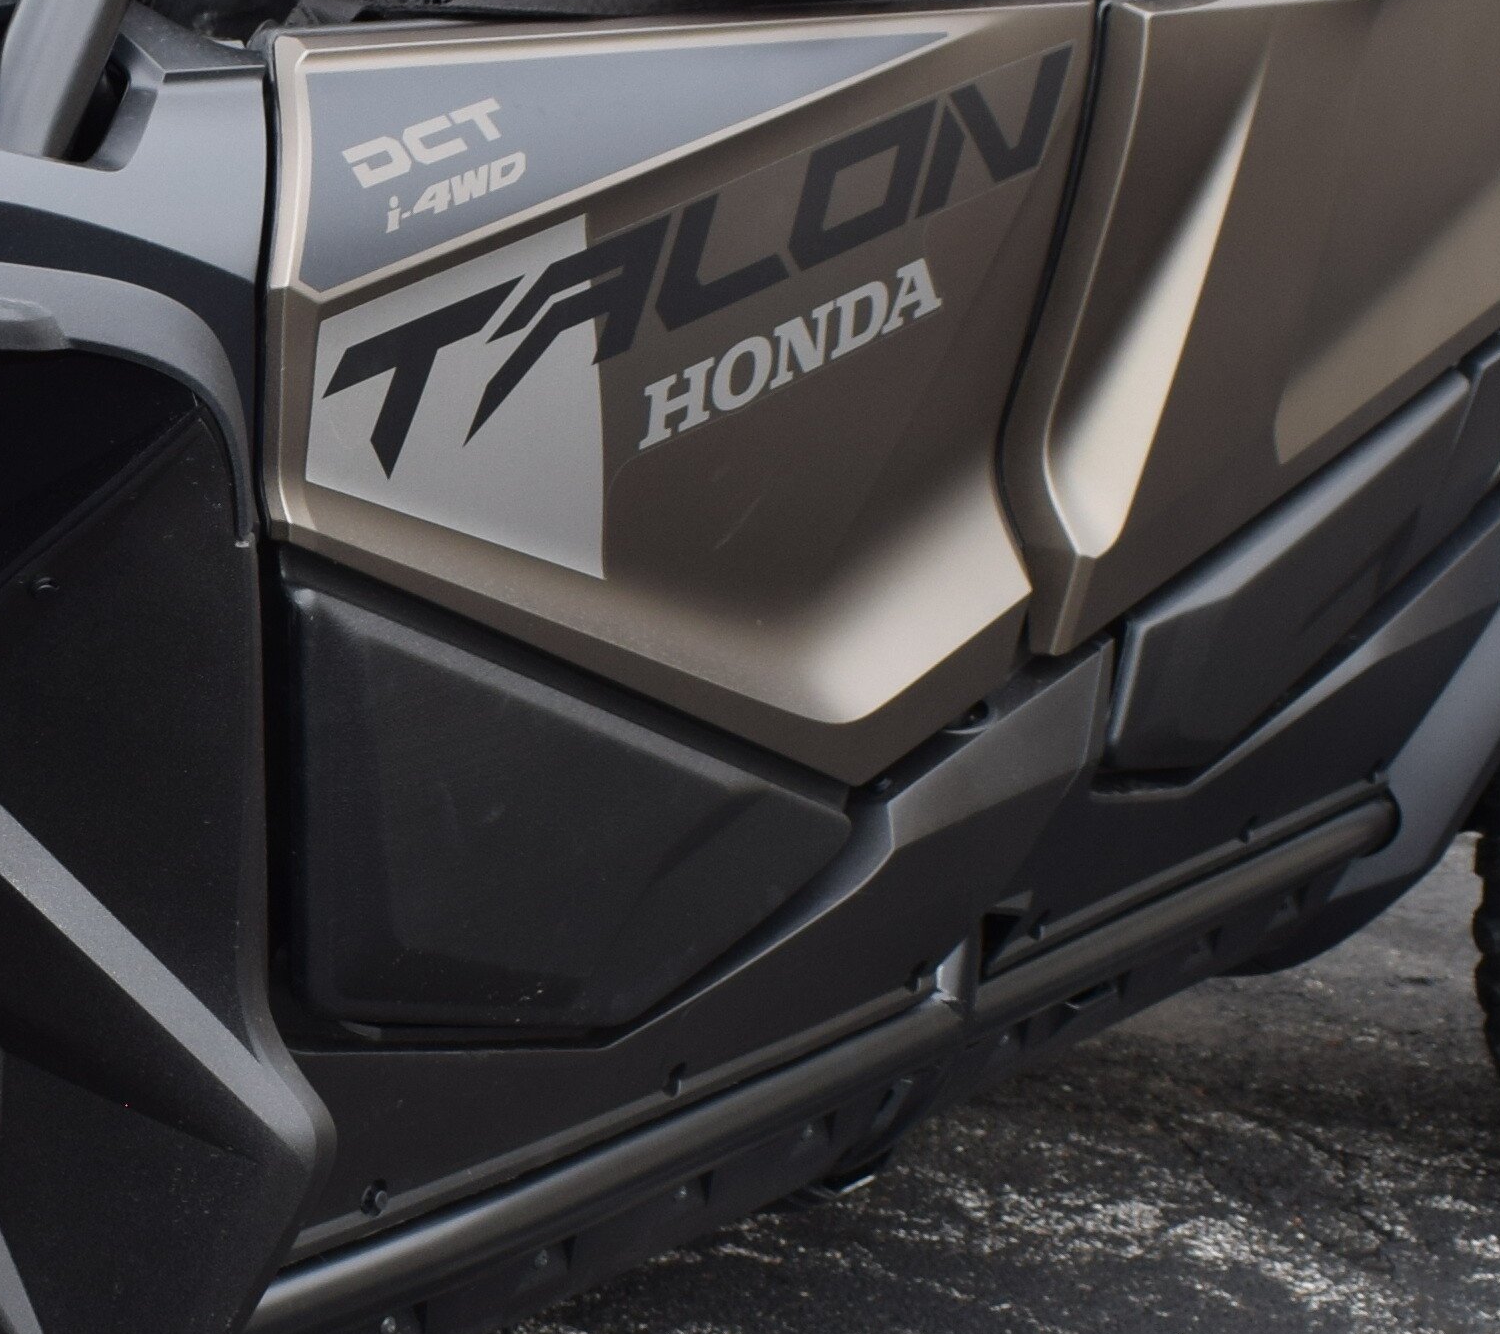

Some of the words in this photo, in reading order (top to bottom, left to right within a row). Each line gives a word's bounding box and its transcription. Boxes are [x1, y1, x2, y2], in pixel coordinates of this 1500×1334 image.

[342, 97, 502, 189] DCT
[385, 151, 526, 234] i-4WD
[322, 43, 1074, 480] TALON
[638, 258, 942, 451] HONDA
